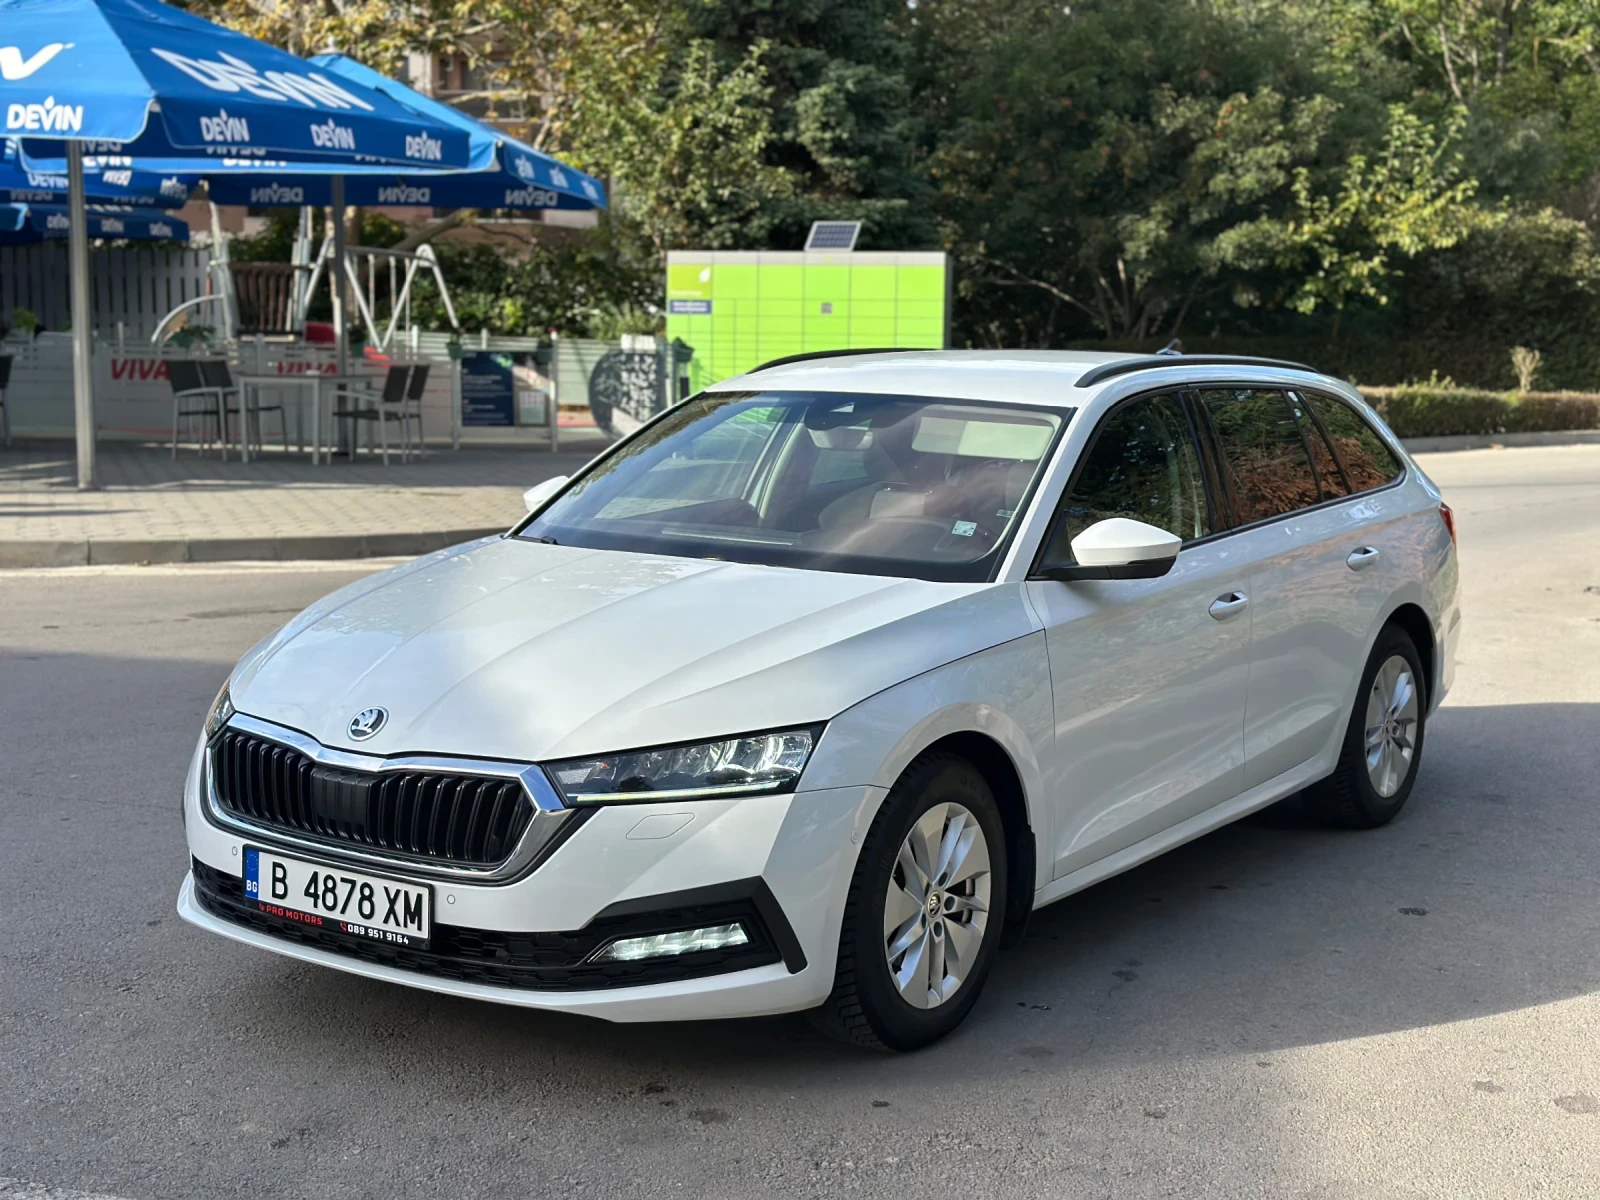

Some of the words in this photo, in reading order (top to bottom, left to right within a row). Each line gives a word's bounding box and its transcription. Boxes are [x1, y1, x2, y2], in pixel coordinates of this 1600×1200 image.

[6, 97, 83, 131] DEVIN
[200, 110, 249, 142] DEVIN
[310, 119, 355, 149] DEVIN
[405, 132, 442, 160] DEVIN
[111, 358, 170, 380] VIVA
[246, 879, 258, 893] BG
[271, 861, 288, 900] B
[303, 871, 375, 920] 4878
[382, 886, 423, 931] XM
[266, 905, 284, 916] PRO
[285, 910, 323, 925] MOTORS
[347, 924, 365, 935] 089
[367, 928, 384, 939] 951
[386, 932, 409, 945] 9164
